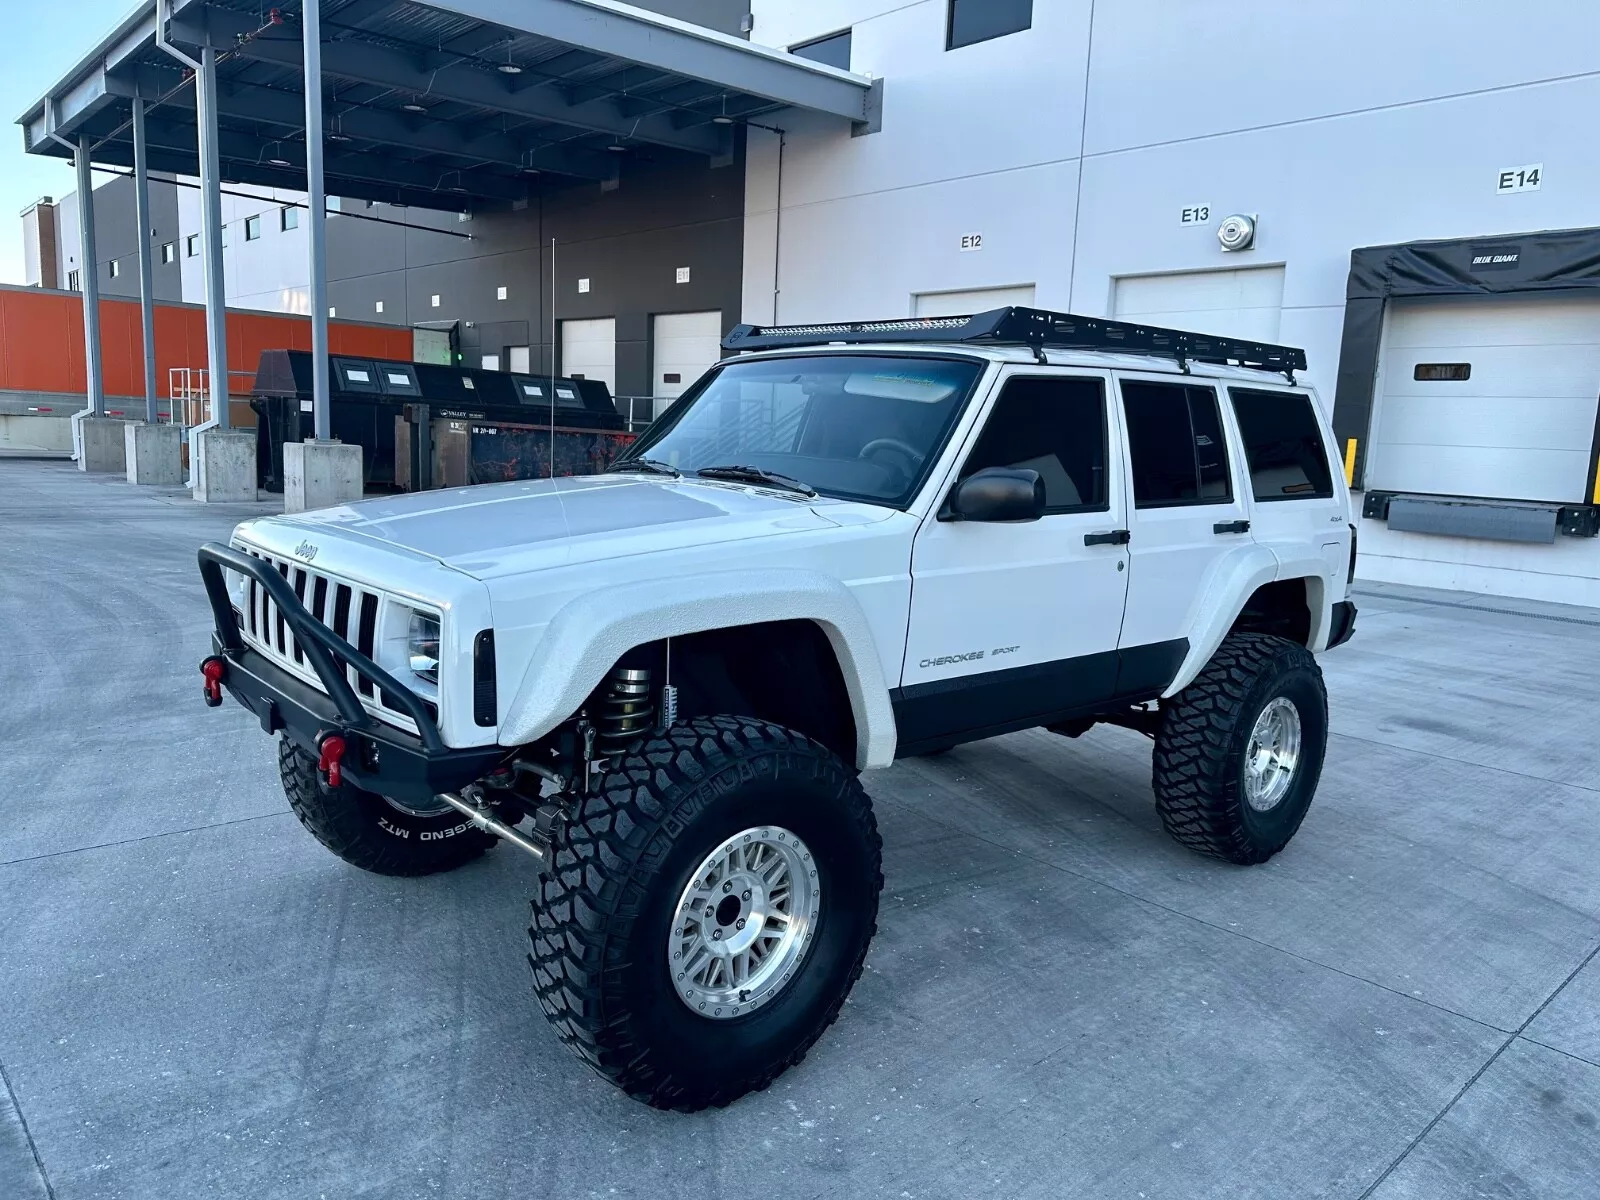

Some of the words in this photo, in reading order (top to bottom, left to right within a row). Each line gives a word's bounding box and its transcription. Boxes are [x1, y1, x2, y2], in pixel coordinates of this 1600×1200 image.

[1499, 168, 1540, 189] E14
[1181, 206, 1209, 223] E13
[961, 234, 982, 248] E12
[1472, 256, 1493, 264] BLUE
[448, 410, 467, 418] VALLEY
[294, 539, 318, 563] Jeep
[919, 650, 985, 668] CHEROKEE
[991, 645, 1020, 656] SPORT
[377, 816, 410, 839] MTZ
[420, 818, 476, 841] EGEND
